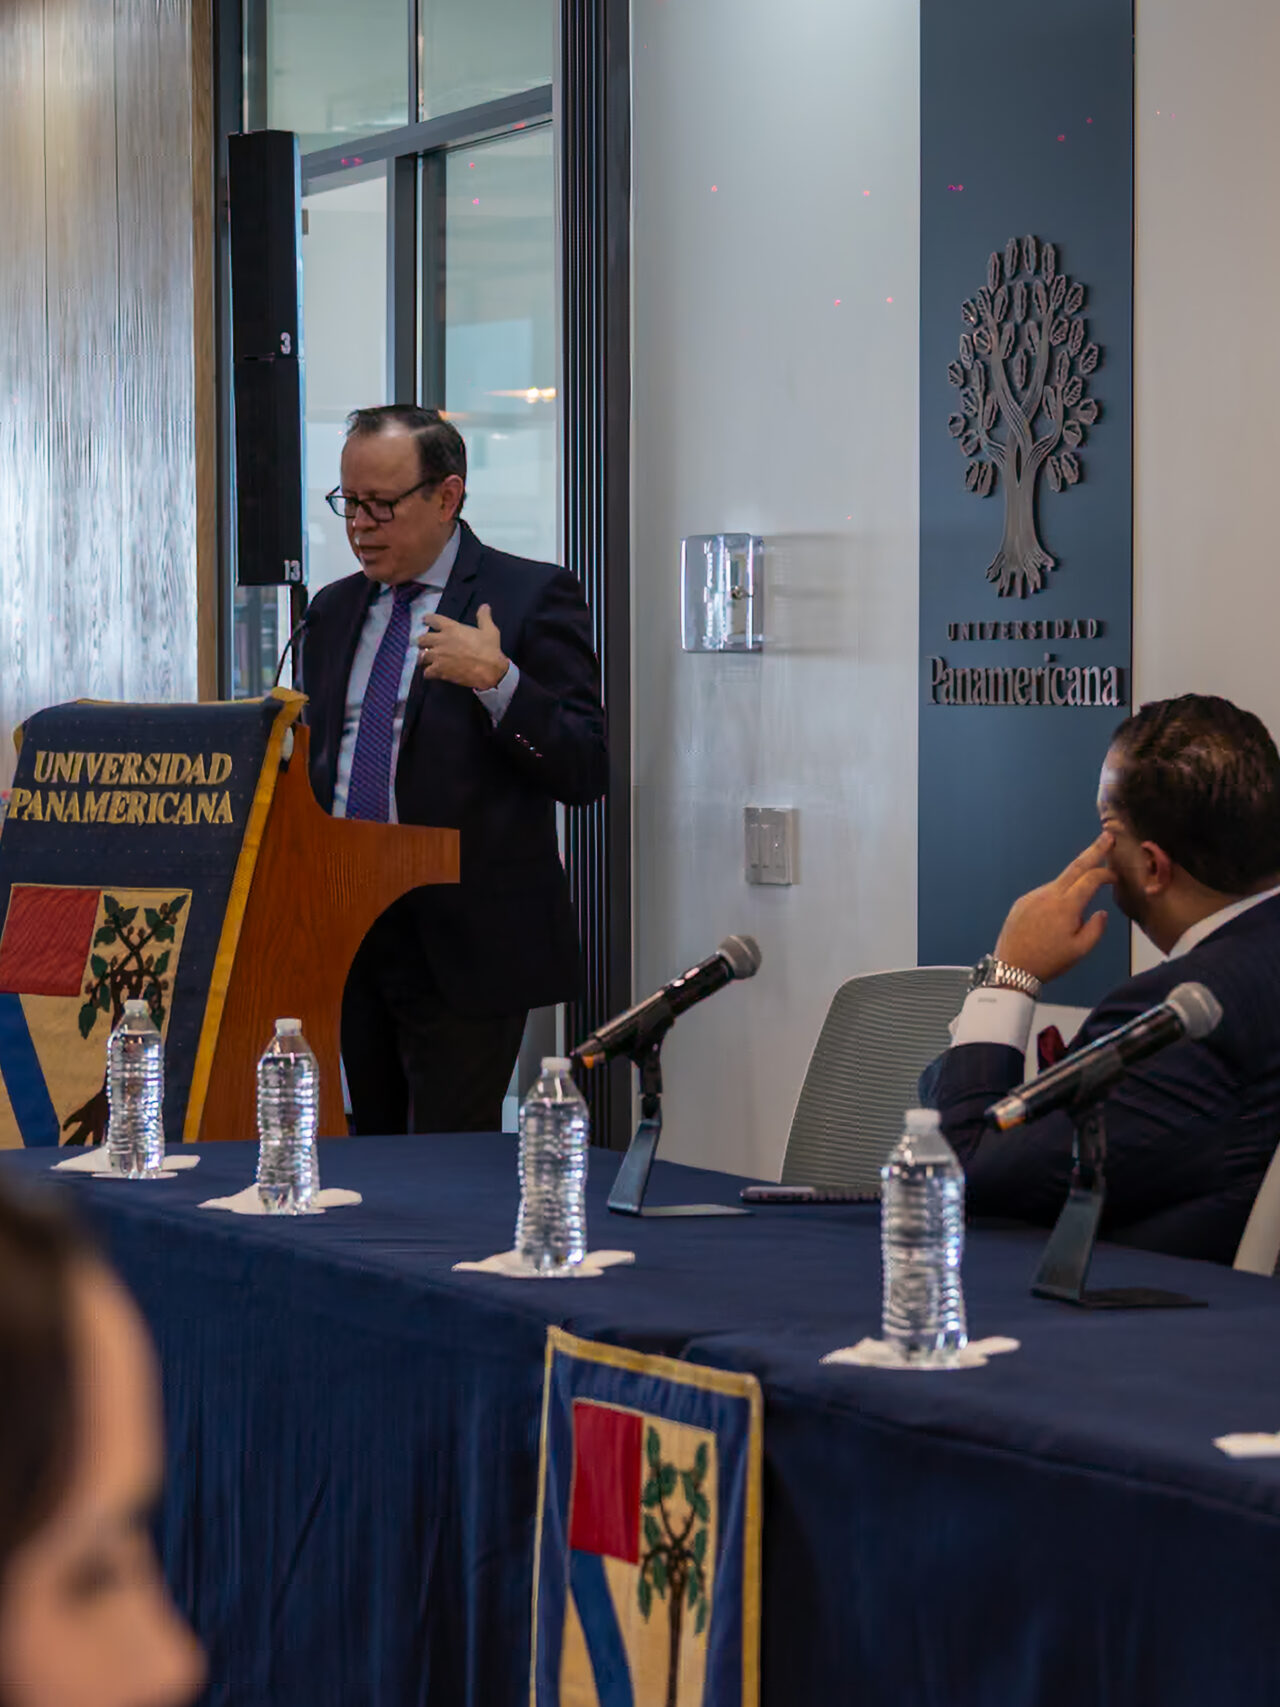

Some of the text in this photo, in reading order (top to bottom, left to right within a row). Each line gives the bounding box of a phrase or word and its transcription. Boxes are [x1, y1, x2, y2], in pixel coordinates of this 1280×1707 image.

[280, 332, 291, 355] 3
[284, 559, 301, 581] 13
[947, 618, 1098, 641] UNIVERSIDAD
[926, 652, 1120, 707] Panamericana
[33, 750, 233, 785] UNIVERSIDAD
[7, 787, 234, 825] PANAMERICANA
